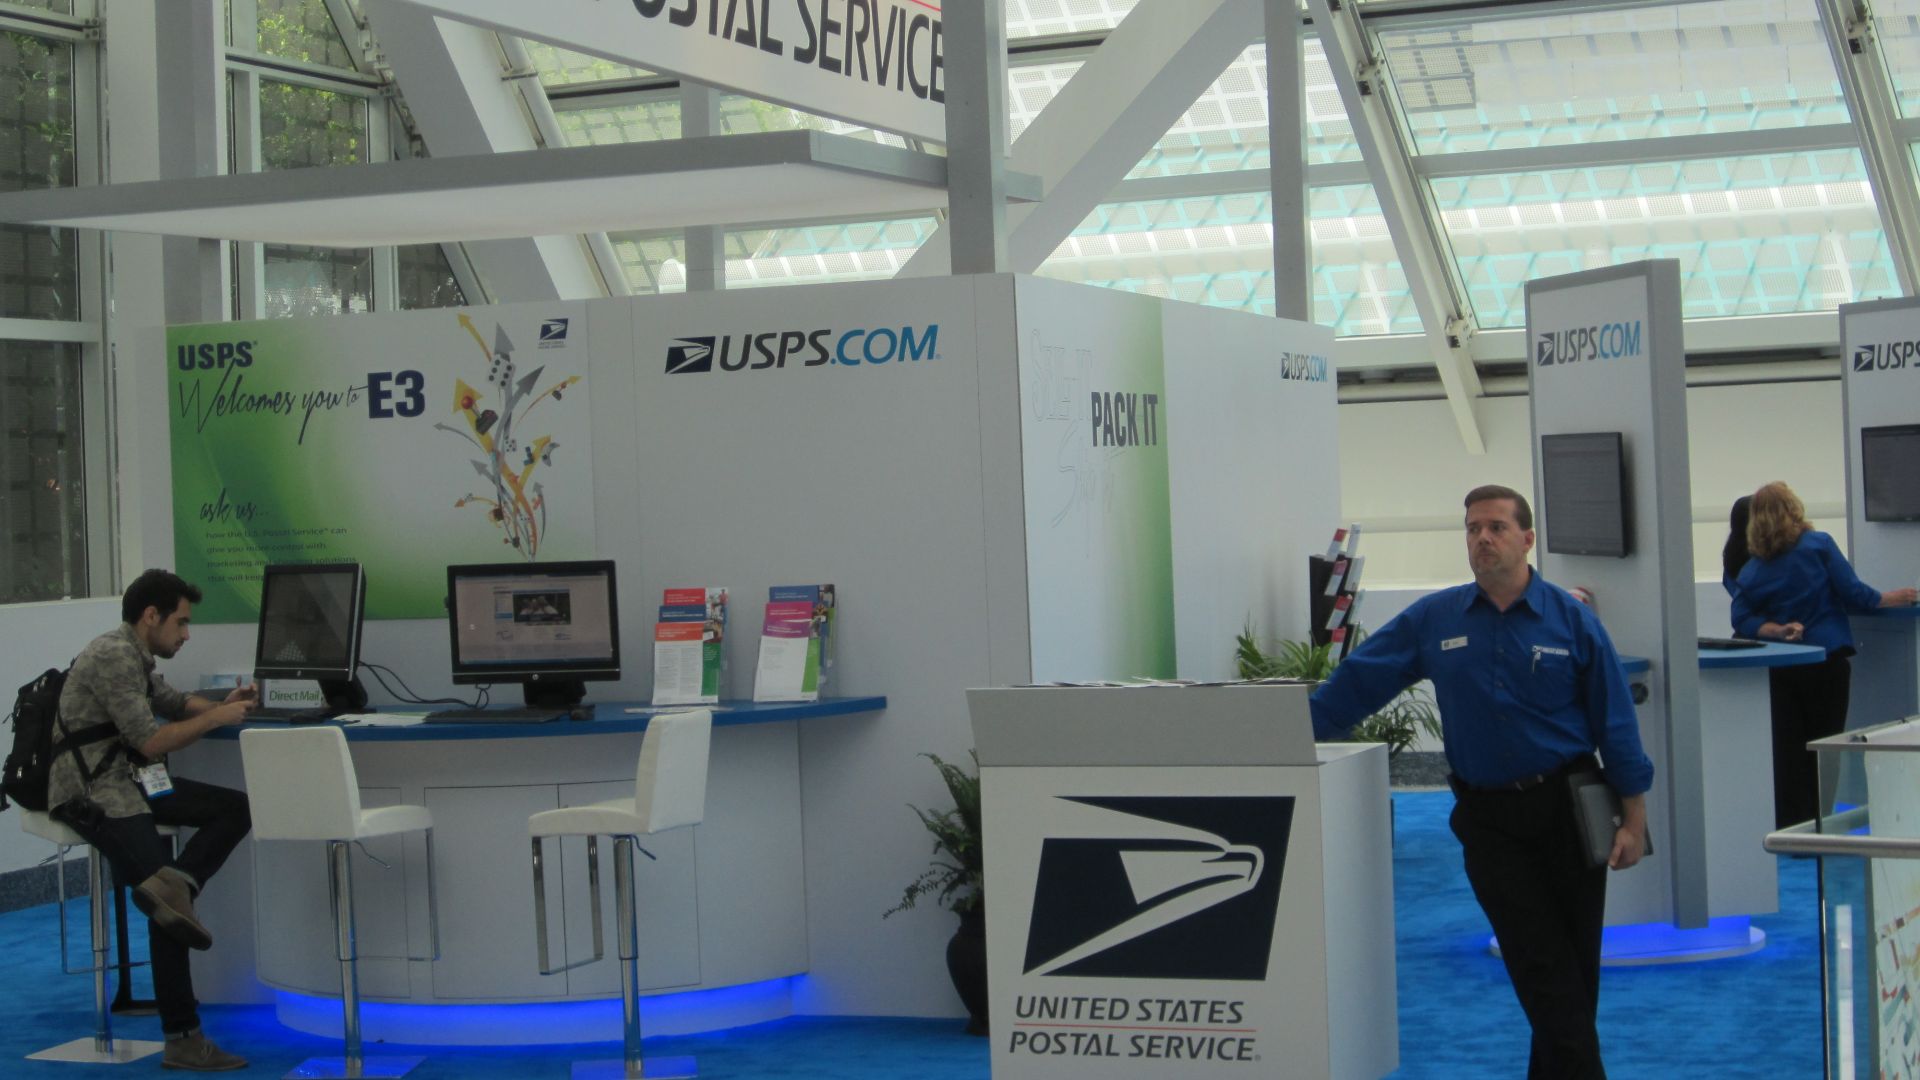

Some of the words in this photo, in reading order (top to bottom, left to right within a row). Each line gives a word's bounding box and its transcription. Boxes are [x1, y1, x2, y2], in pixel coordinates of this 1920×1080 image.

[719, 325, 939, 371] USPS.COM
[1557, 320, 1641, 365] USPS.COM
[1290, 352, 1328, 382] USPS.COM
[179, 358, 297, 434] Welcomes
[298, 390, 344, 445] you
[346, 384, 368, 407] to
[368, 370, 426, 419] E3
[1091, 392, 1139, 447] PACK
[1142, 393, 1158, 446] IT
[200, 487, 232, 523] ask
[227, 530, 242, 538] the
[269, 690, 298, 702] Direct
[300, 690, 320, 702] Mail
[1015, 995, 1130, 1021] UNITED
[1136, 998, 1245, 1024] STATES
[1009, 1030, 1121, 1057] POSTAL
[1128, 1034, 1256, 1062] SERVICE
